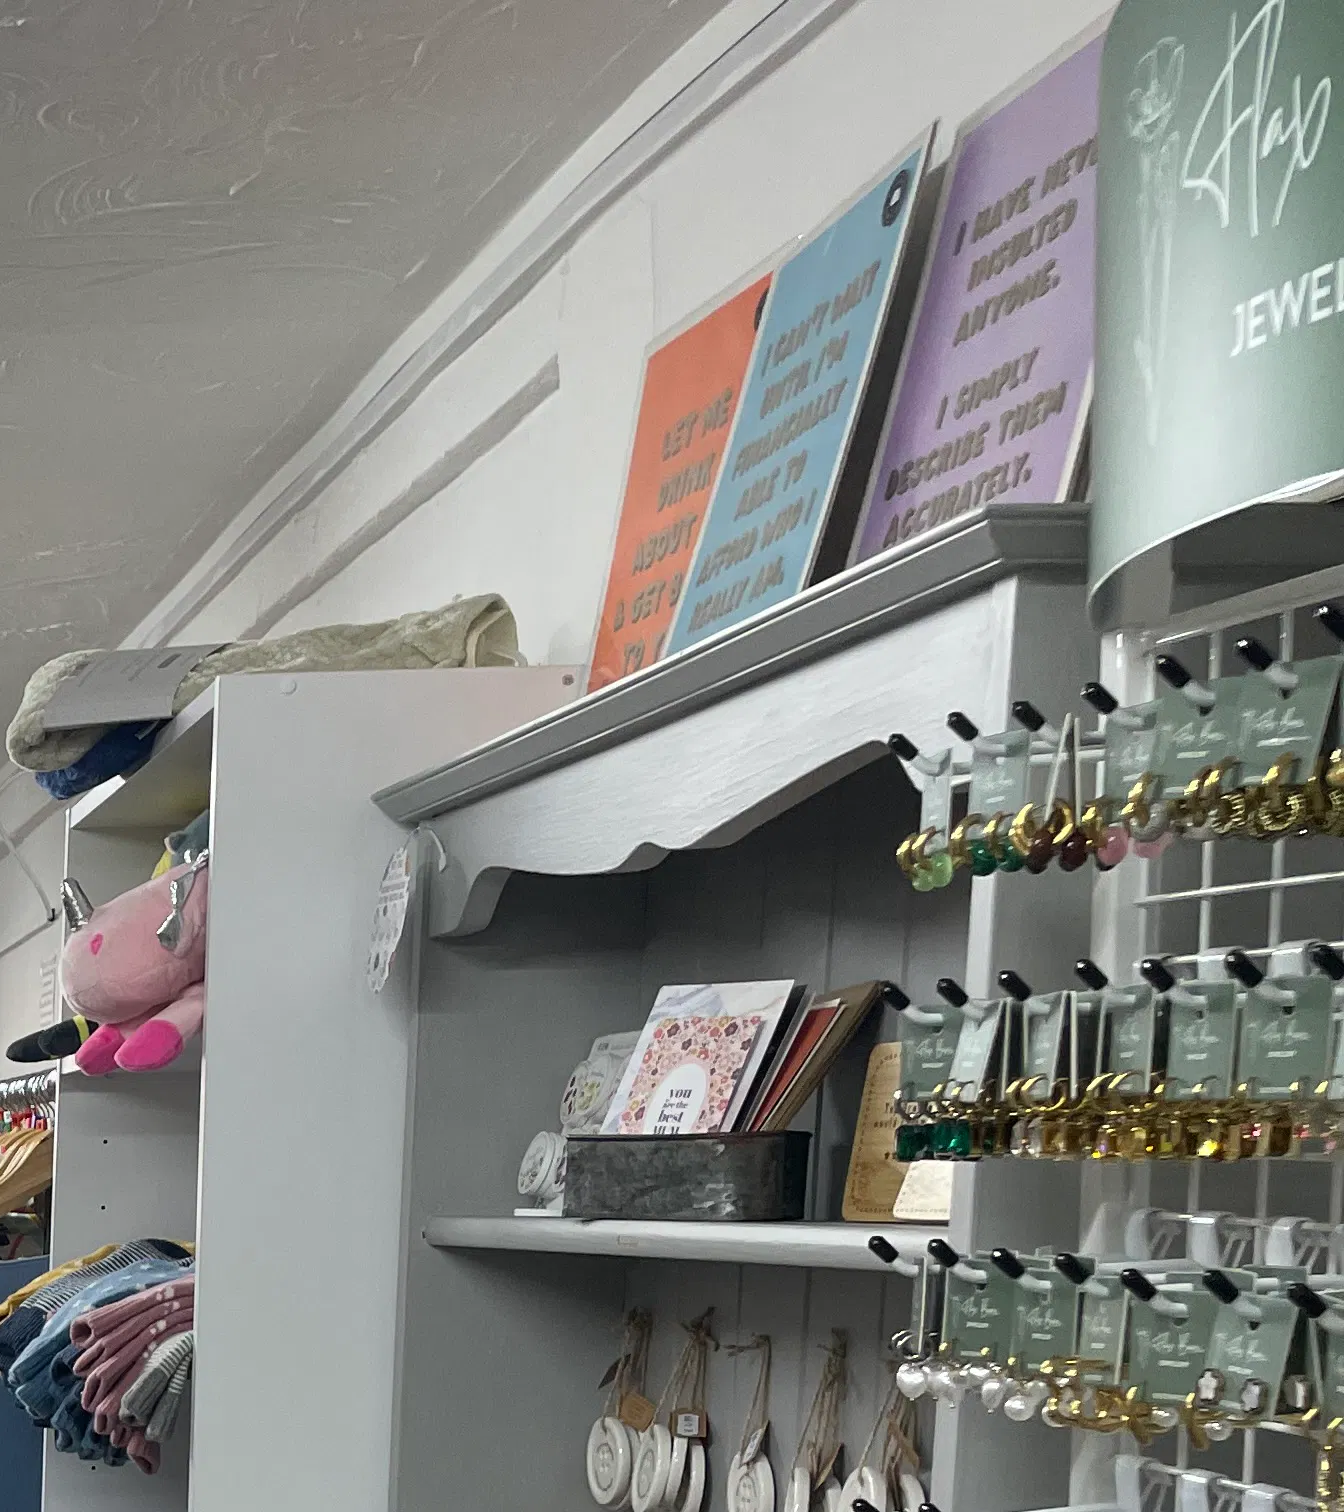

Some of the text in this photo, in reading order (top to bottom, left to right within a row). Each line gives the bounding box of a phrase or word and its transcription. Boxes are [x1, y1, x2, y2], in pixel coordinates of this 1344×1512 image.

[953, 133, 1098, 257] I HAVE NEVE
[967, 198, 1078, 292] INSULTED
[761, 343, 772, 378] I
[830, 259, 882, 323] WAIT
[952, 258, 1061, 348] ANYONE.
[661, 387, 732, 461] LET ME
[730, 378, 849, 481] FINANCIALLY
[759, 358, 812, 419] UNTIL
[936, 346, 1041, 430] I SIMPLY
[884, 381, 1070, 501] DESCRIBE THEM
[734, 448, 808, 522] ABLE TO
[883, 451, 1033, 548] ACCURATELY.
[632, 513, 698, 576] ABOUT
[695, 527, 759, 588] AFFORD
[760, 501, 804, 550] WHO
[631, 585, 666, 624] GET
[687, 575, 751, 633] REALLY
[658, 1111, 683, 1123] best
[669, 1089, 692, 1099] you
